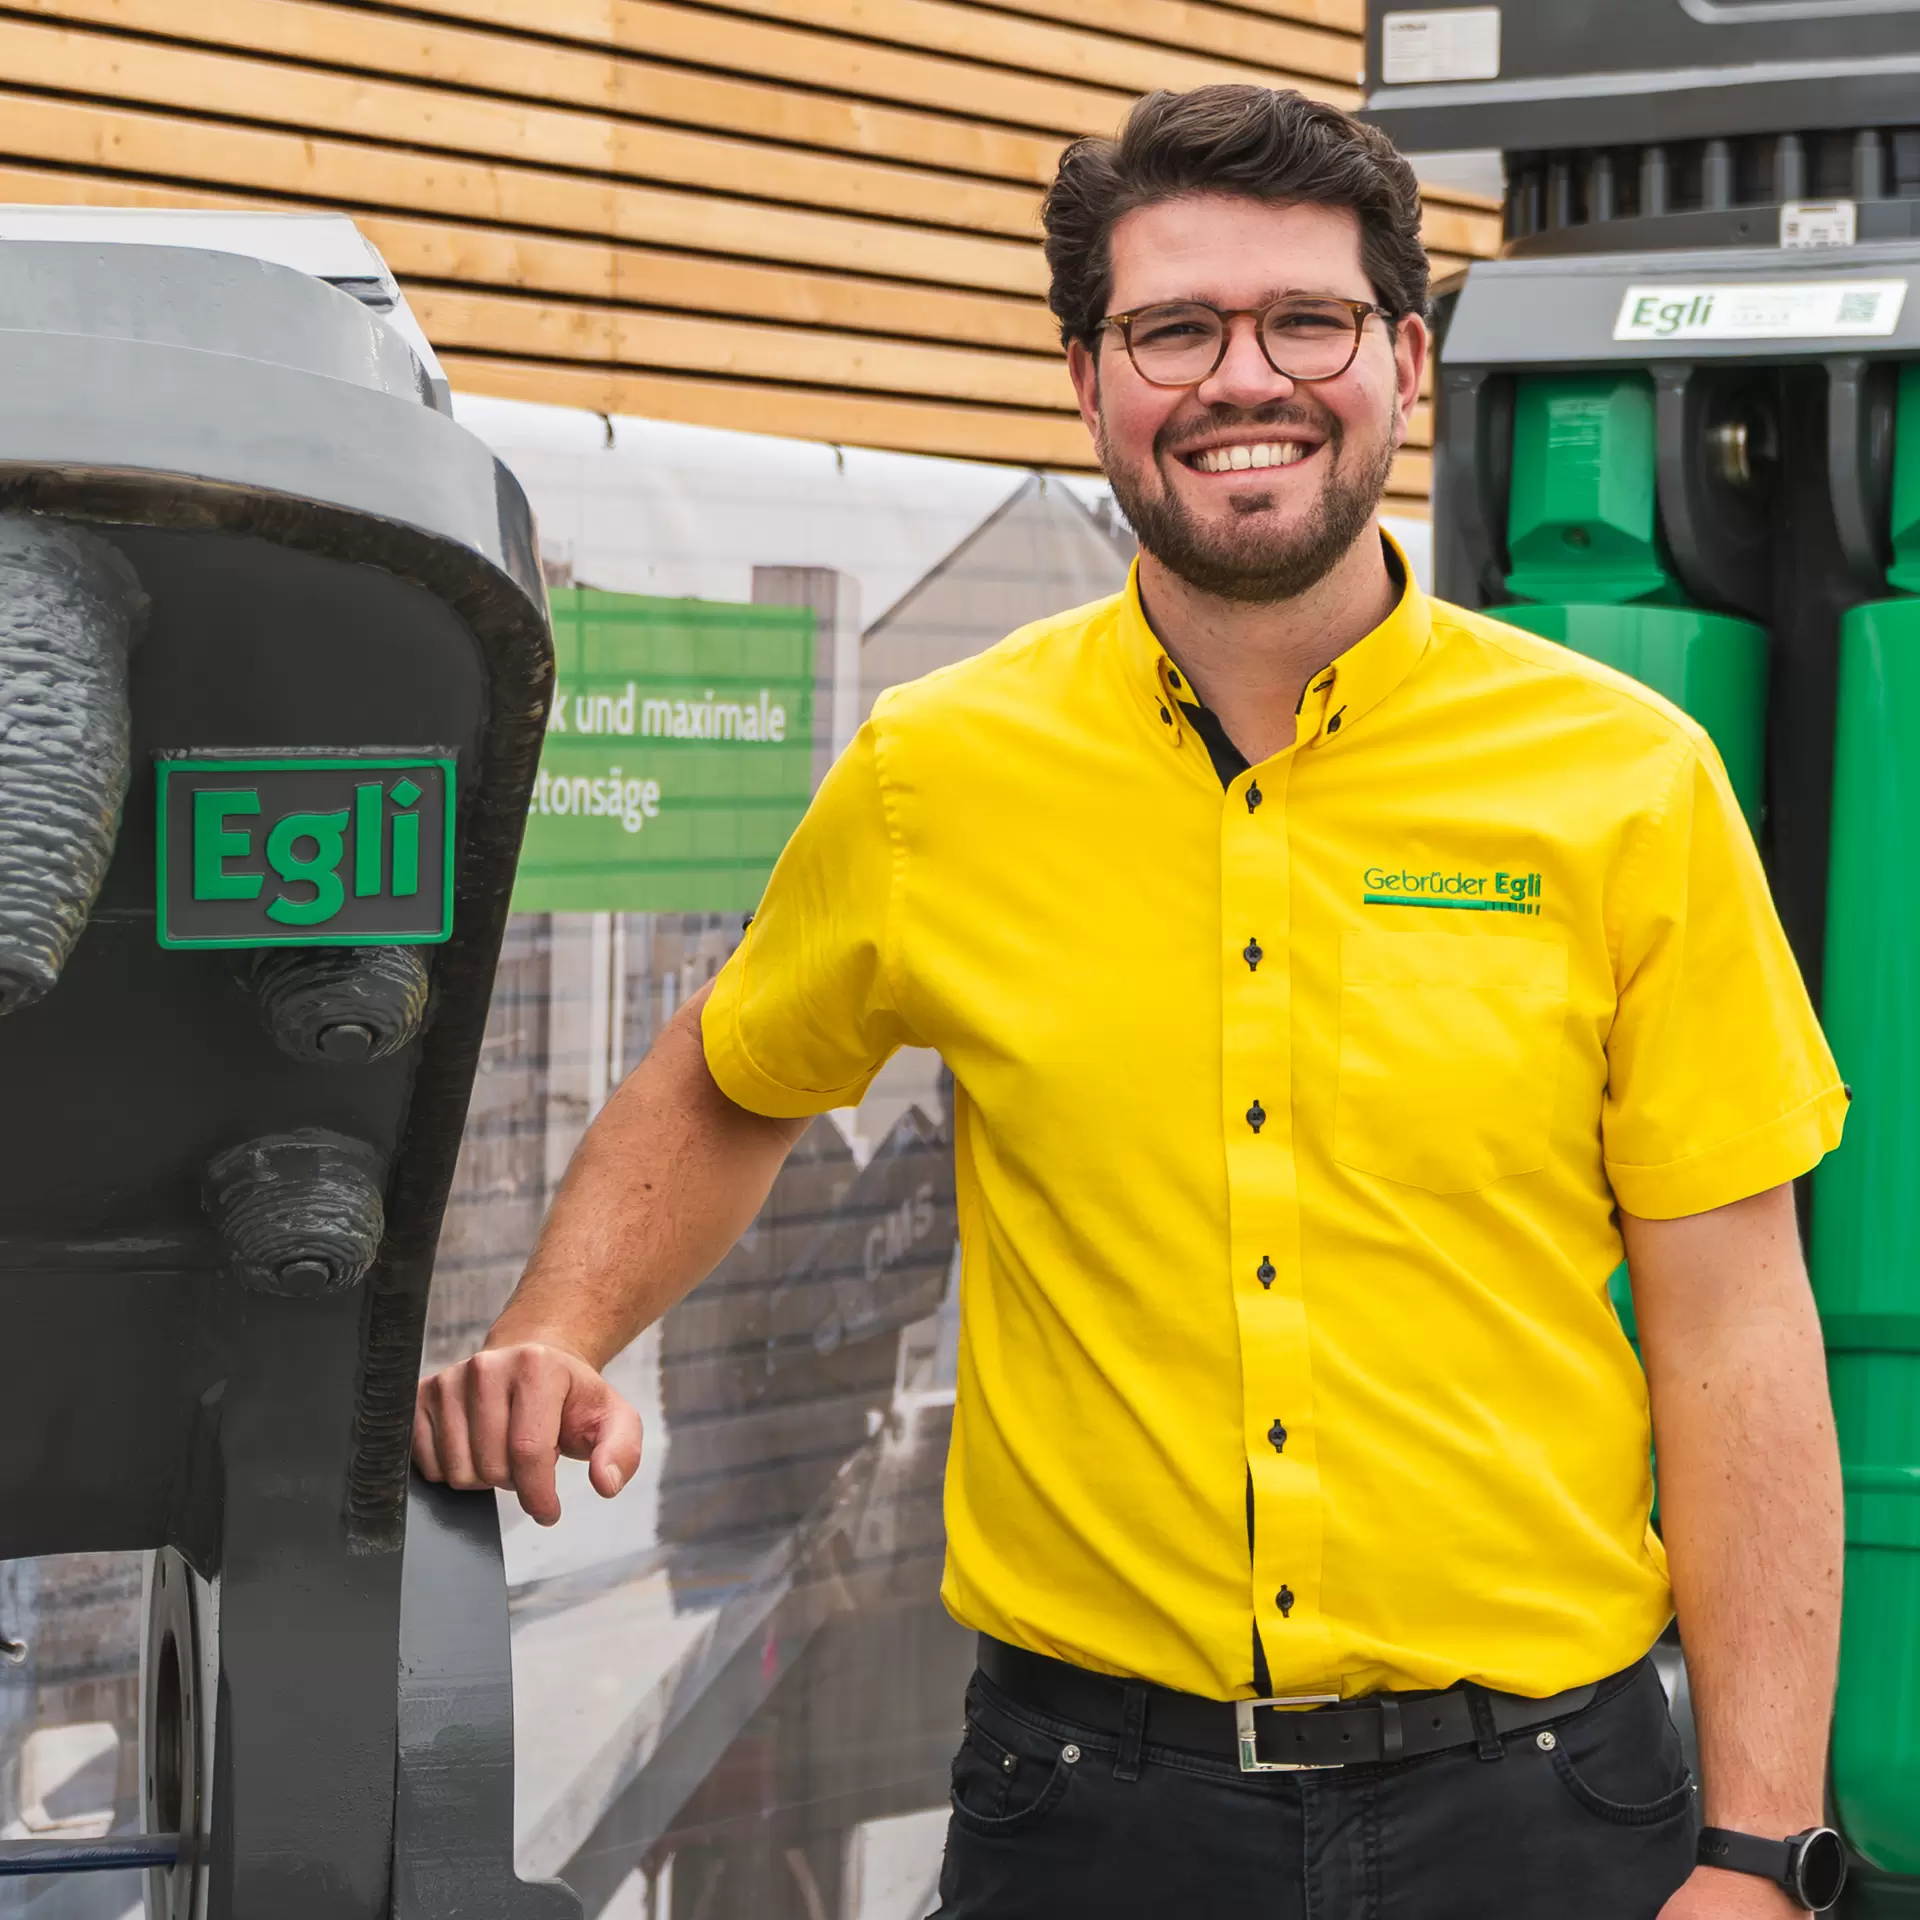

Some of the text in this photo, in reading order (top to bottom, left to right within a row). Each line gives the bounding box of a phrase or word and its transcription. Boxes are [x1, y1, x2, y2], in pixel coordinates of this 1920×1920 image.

[1631, 294, 1716, 335] Egli
[575, 681, 635, 735] und
[641, 688, 786, 741] maximale
[192, 777, 423, 926] Egli
[1363, 867, 1542, 901] Gebrüder Egli
